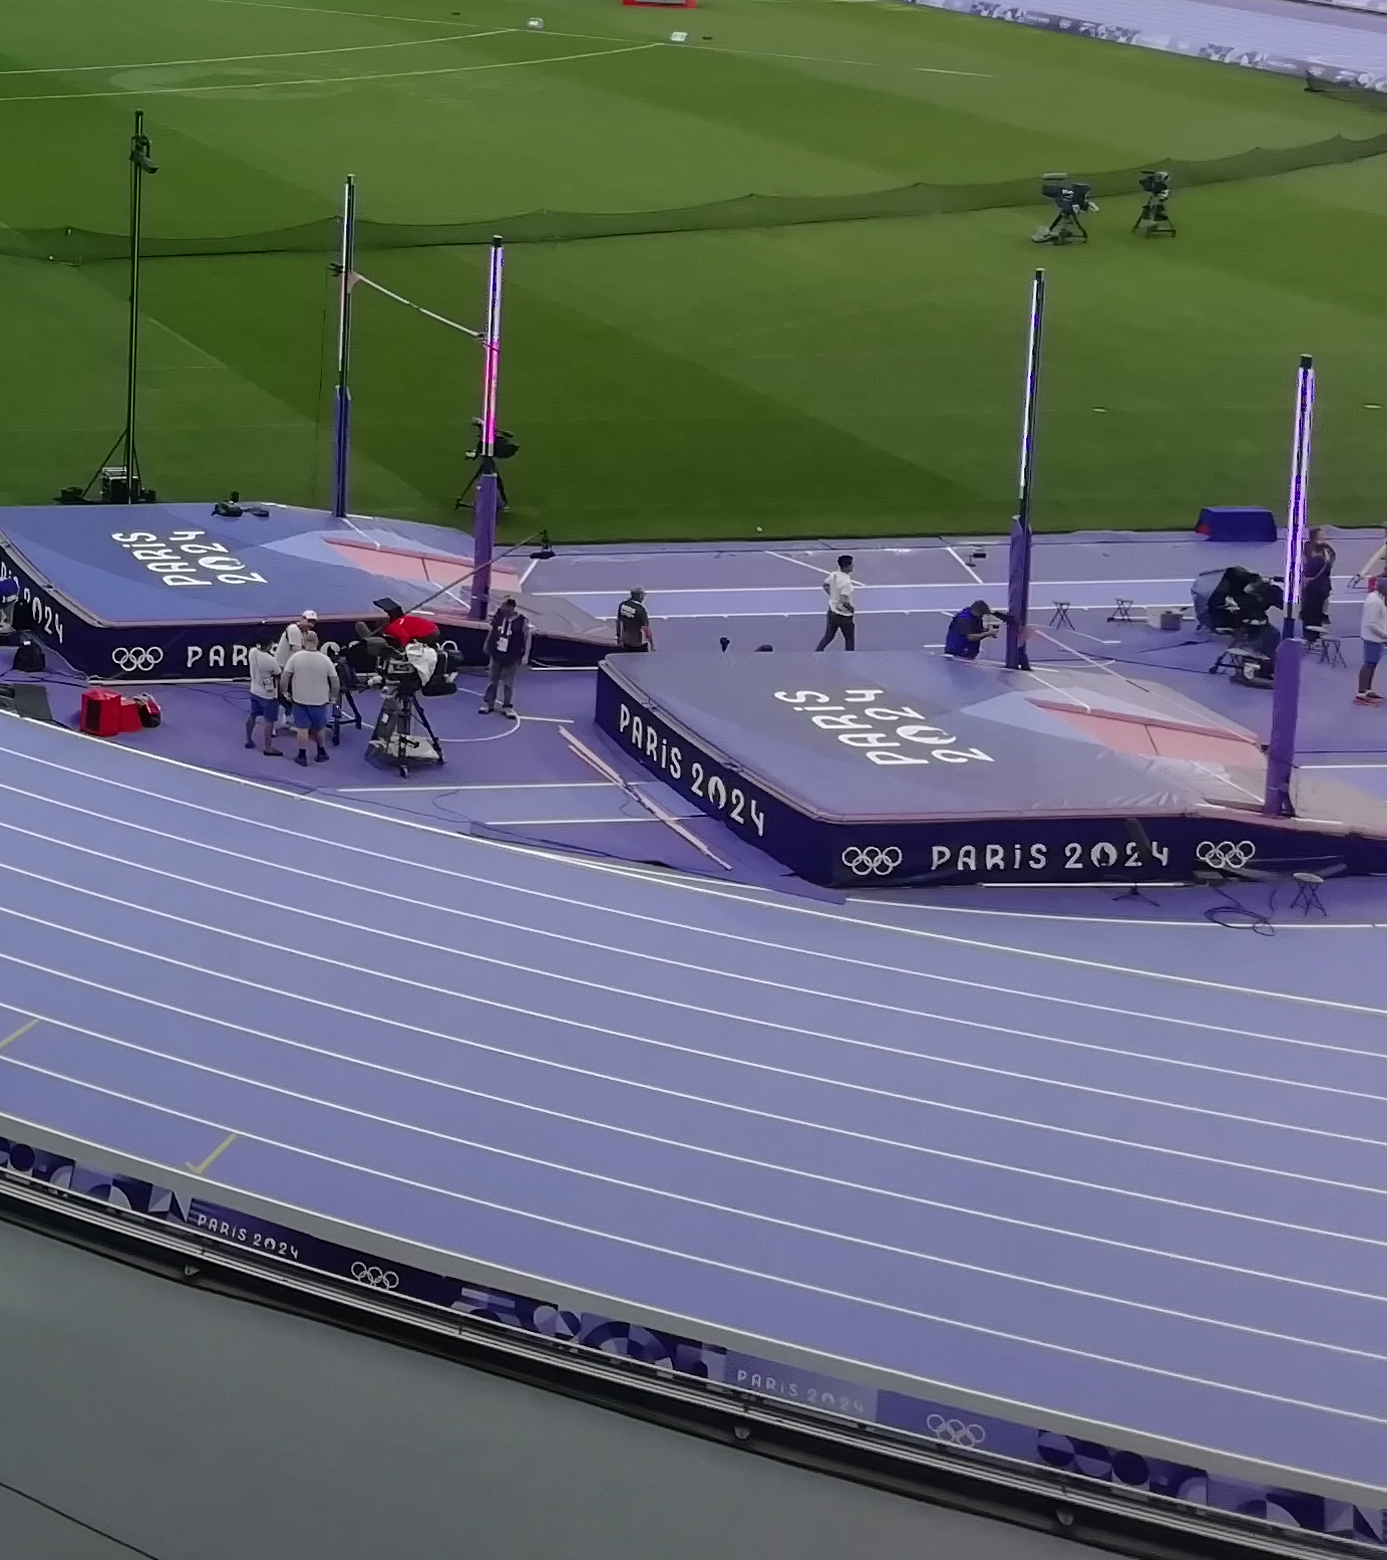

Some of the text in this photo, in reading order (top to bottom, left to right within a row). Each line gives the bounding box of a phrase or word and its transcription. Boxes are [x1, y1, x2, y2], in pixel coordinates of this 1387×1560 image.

[112, 531, 269, 586] PARIS 2024
[187, 644, 250, 668] PAR
[773, 689, 996, 765] PARIS 2024
[619, 703, 765, 837] PARIS 2024
[930, 841, 1169, 871] PARIS 2024
[198, 1214, 299, 1263] PARIS 2024
[737, 1369, 864, 1413] PARIS 2024
